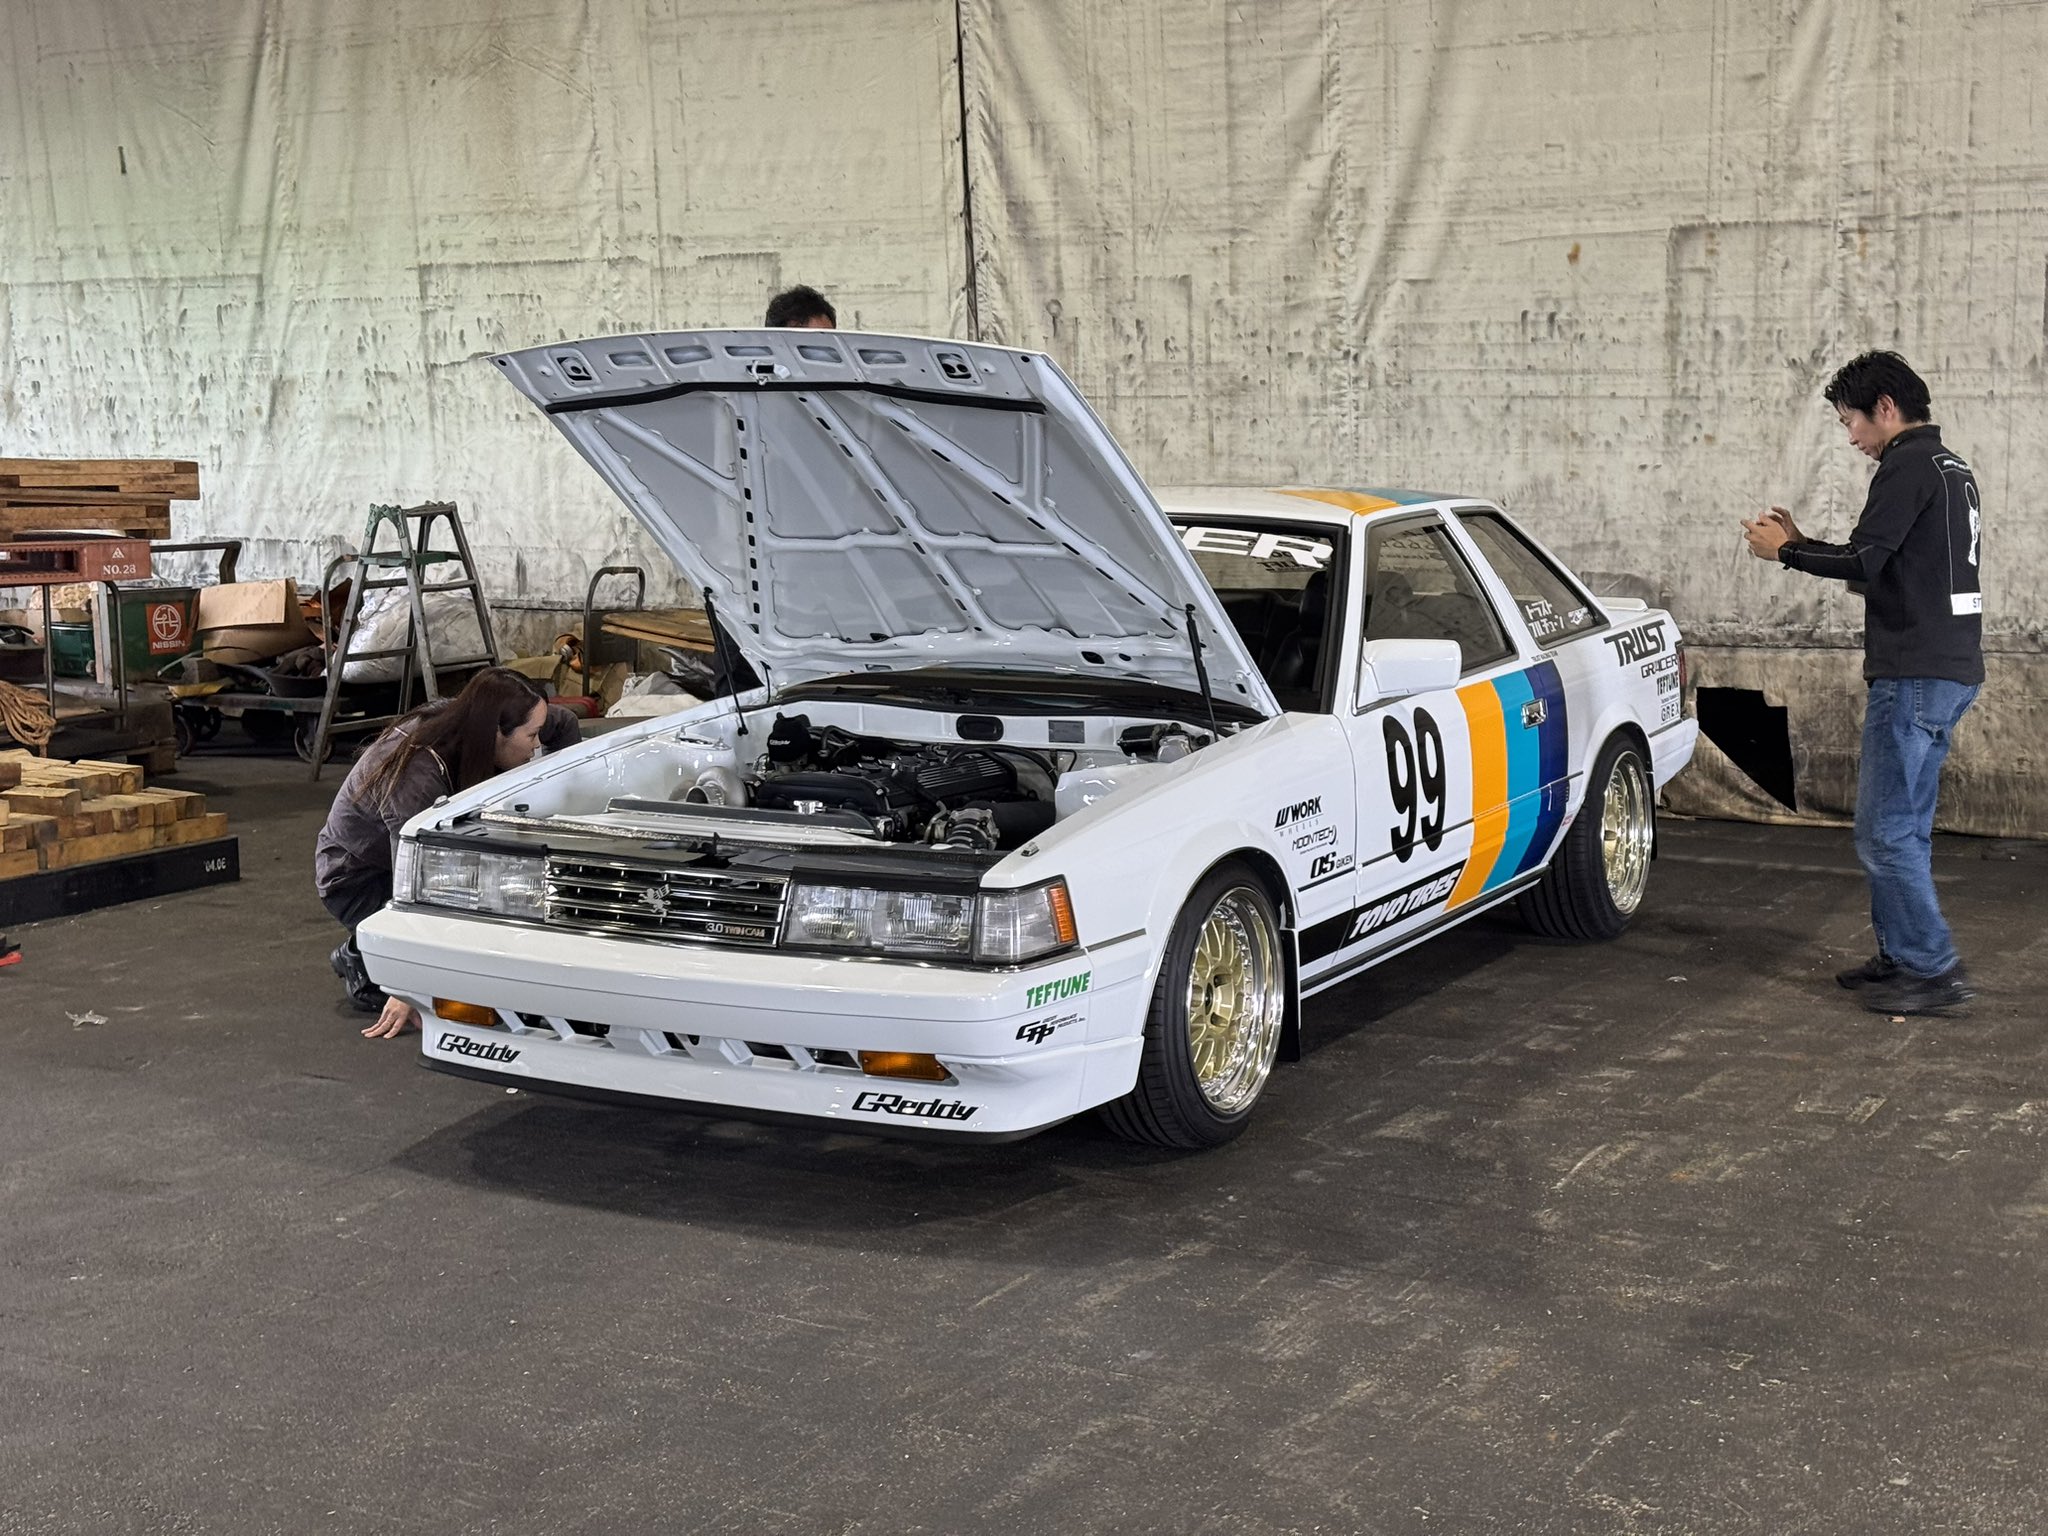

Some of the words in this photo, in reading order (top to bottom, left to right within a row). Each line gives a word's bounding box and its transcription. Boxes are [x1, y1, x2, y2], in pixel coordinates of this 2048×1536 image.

[1173, 525, 1334, 568] ER
[152, 640, 186, 649] NISSIN
[1603, 619, 1665, 667] TRUST
[1382, 706, 1446, 863] 99
[1291, 795, 1321, 822] WORK
[1310, 851, 1337, 879] OS
[1348, 893, 1408, 939] TOYO
[1401, 868, 1461, 915] TIRES
[706, 922, 723, 933] 3.0
[1026, 970, 1091, 1009] TEFTUNE
[852, 1092, 979, 1120] GReddy
